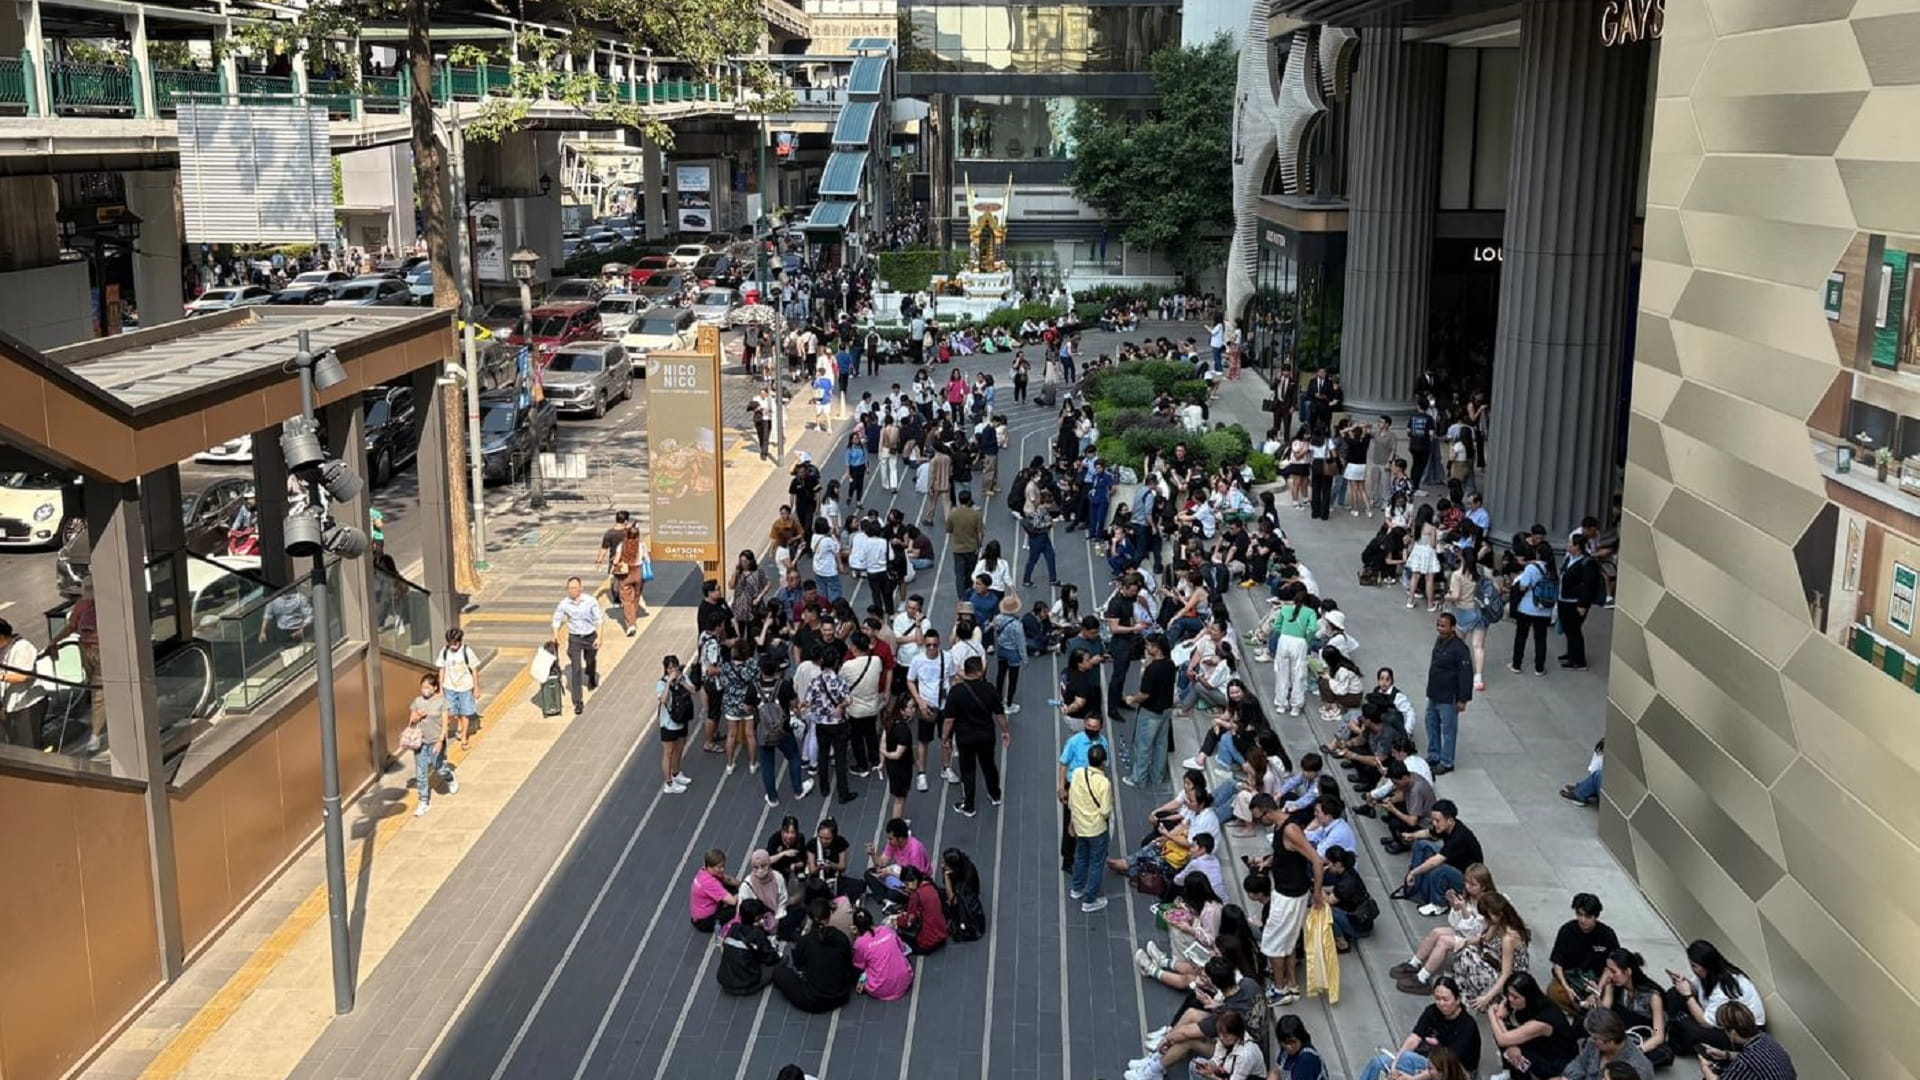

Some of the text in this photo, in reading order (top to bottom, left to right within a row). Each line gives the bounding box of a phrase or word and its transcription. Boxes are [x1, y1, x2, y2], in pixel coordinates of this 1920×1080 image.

[1601, 0, 1665, 47] GAYS
[663, 364, 696, 376] NICO
[663, 375, 696, 388] NICO
